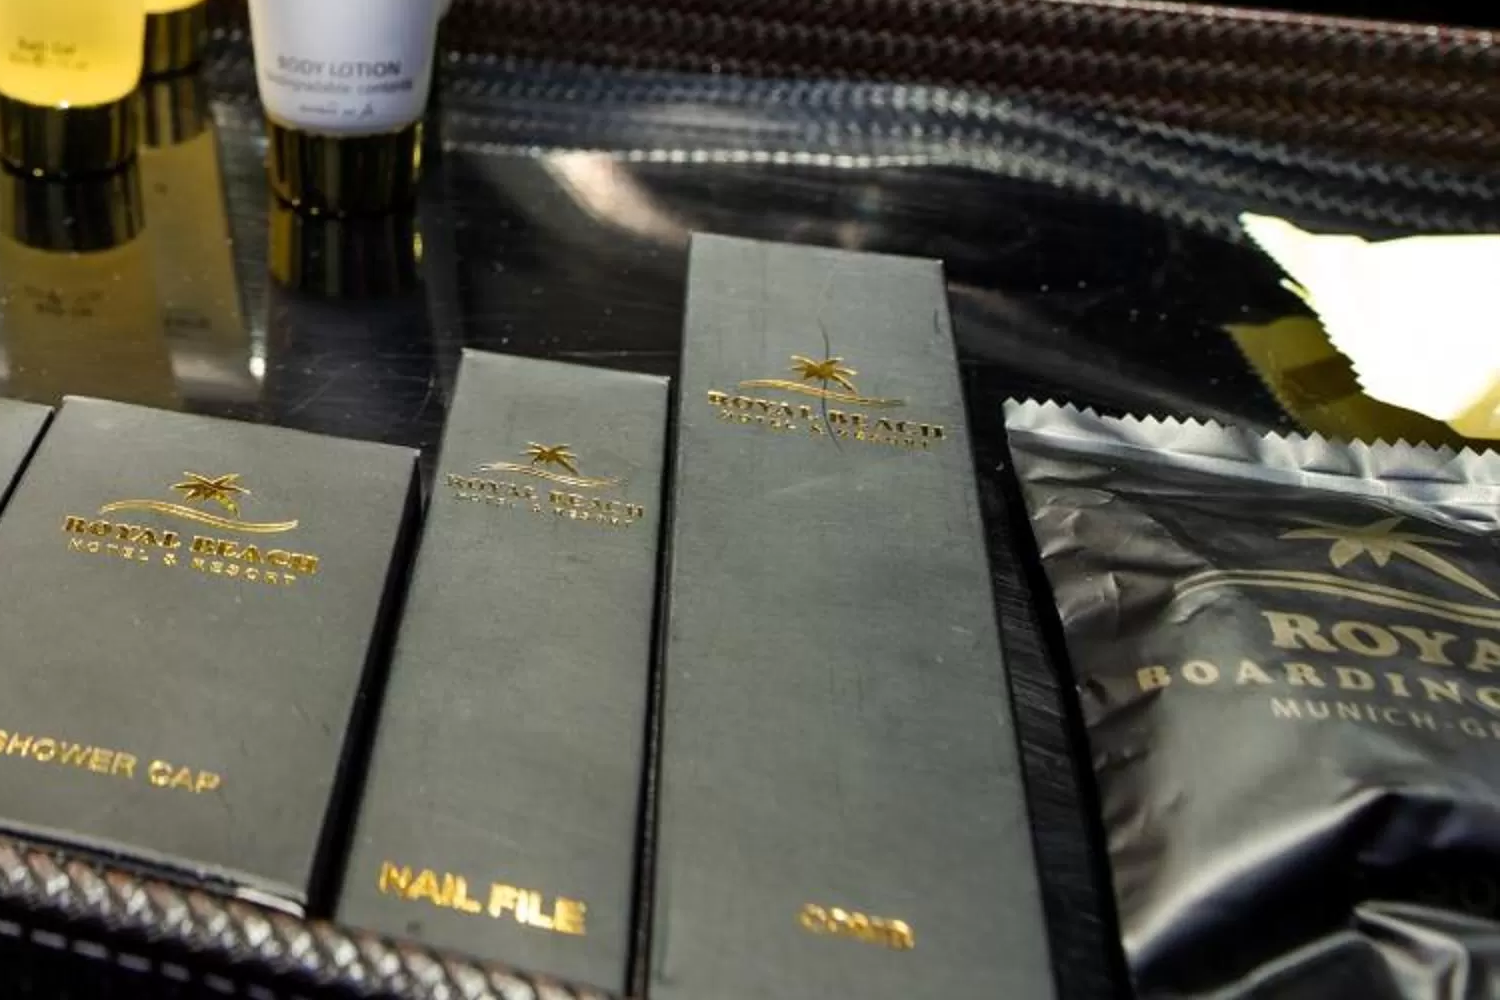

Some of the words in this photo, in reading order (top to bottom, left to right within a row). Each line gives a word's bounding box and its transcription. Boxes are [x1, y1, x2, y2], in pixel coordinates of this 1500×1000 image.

[276, 53, 324, 76] BODY
[329, 58, 402, 79] LOTION
[707, 389, 815, 420] ROYAL
[828, 409, 947, 440] BEACH
[446, 472, 540, 500] ROYAL
[548, 489, 644, 518] BEACH
[63, 514, 181, 549] ROYAL
[189, 535, 321, 575] BEACH
[68, 537, 150, 562] HOTEL
[192, 556, 297, 585] RESORT
[147, 758, 221, 794] CAP
[378, 859, 483, 915] NAIL
[487, 880, 587, 935] FILE
